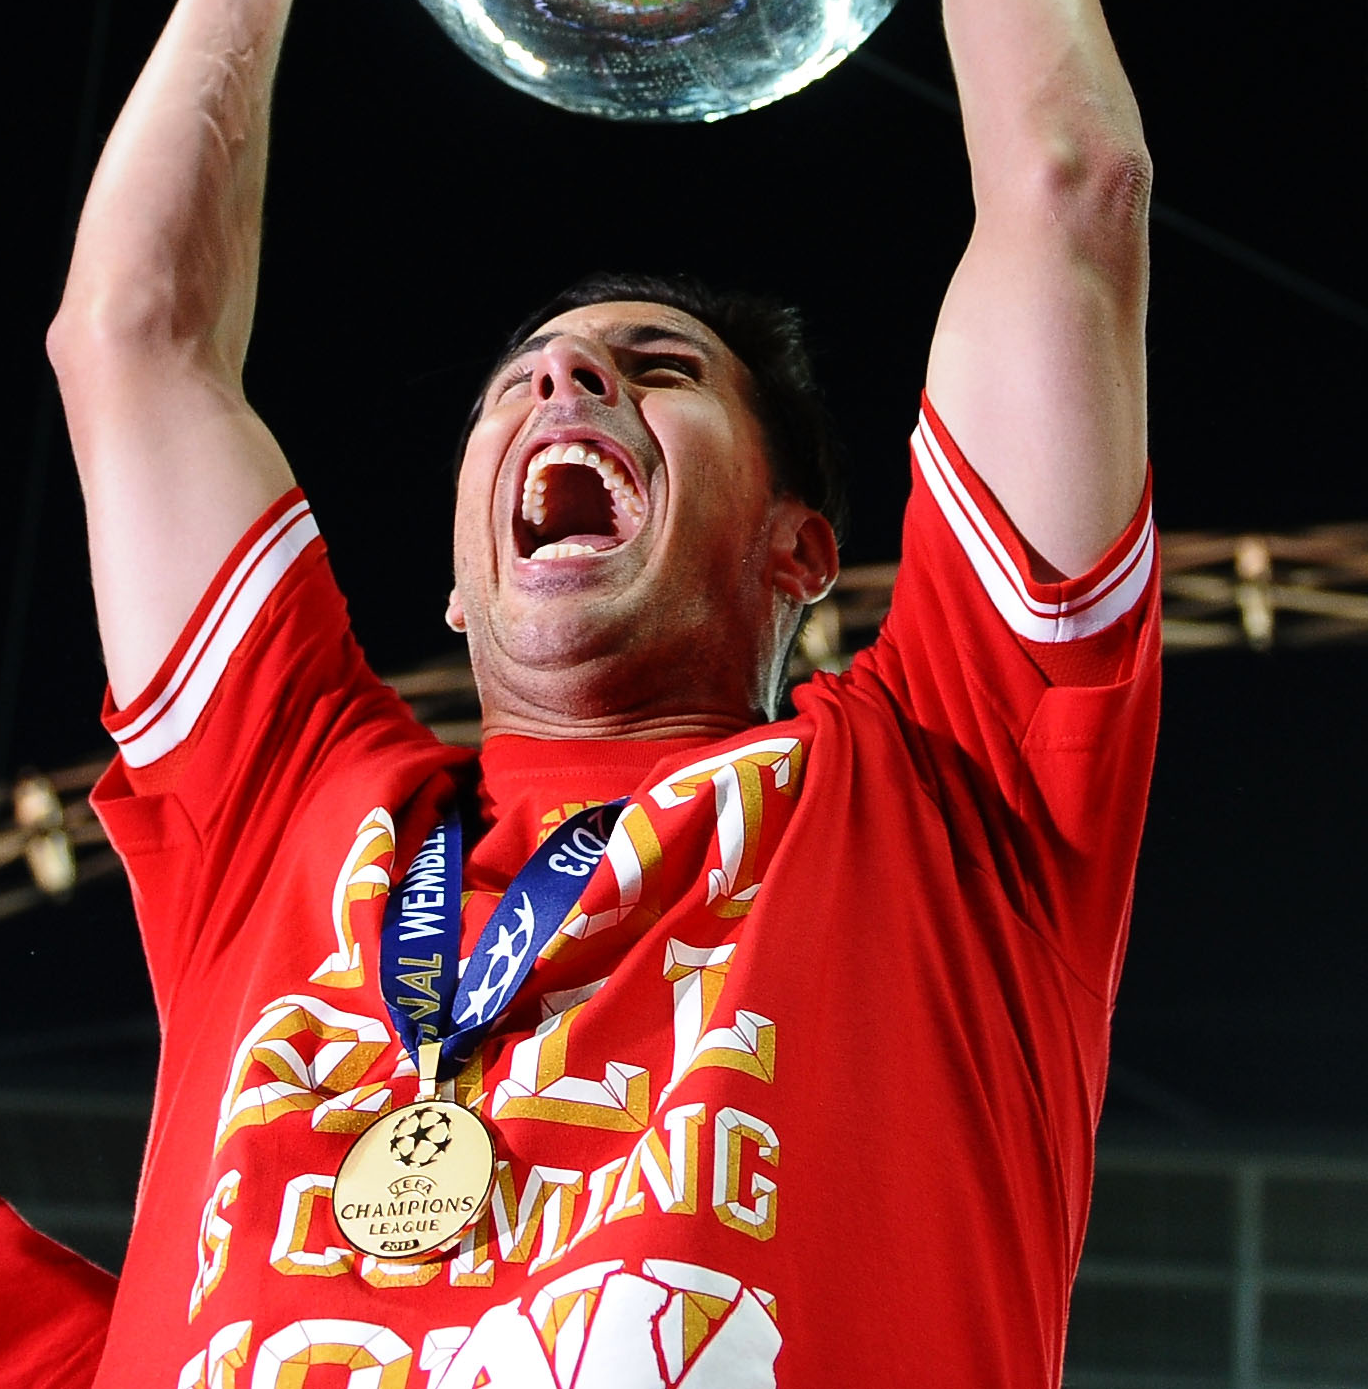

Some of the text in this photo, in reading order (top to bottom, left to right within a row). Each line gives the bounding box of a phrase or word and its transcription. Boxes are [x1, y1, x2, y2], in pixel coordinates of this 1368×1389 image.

[396, 953, 443, 1021] NAL
[269, 1102, 781, 1290] CMING
[388, 1178, 433, 1196] UEFA
[340, 1195, 475, 1221] CHAMPIONS
[369, 1218, 440, 1236] LEAGUE
